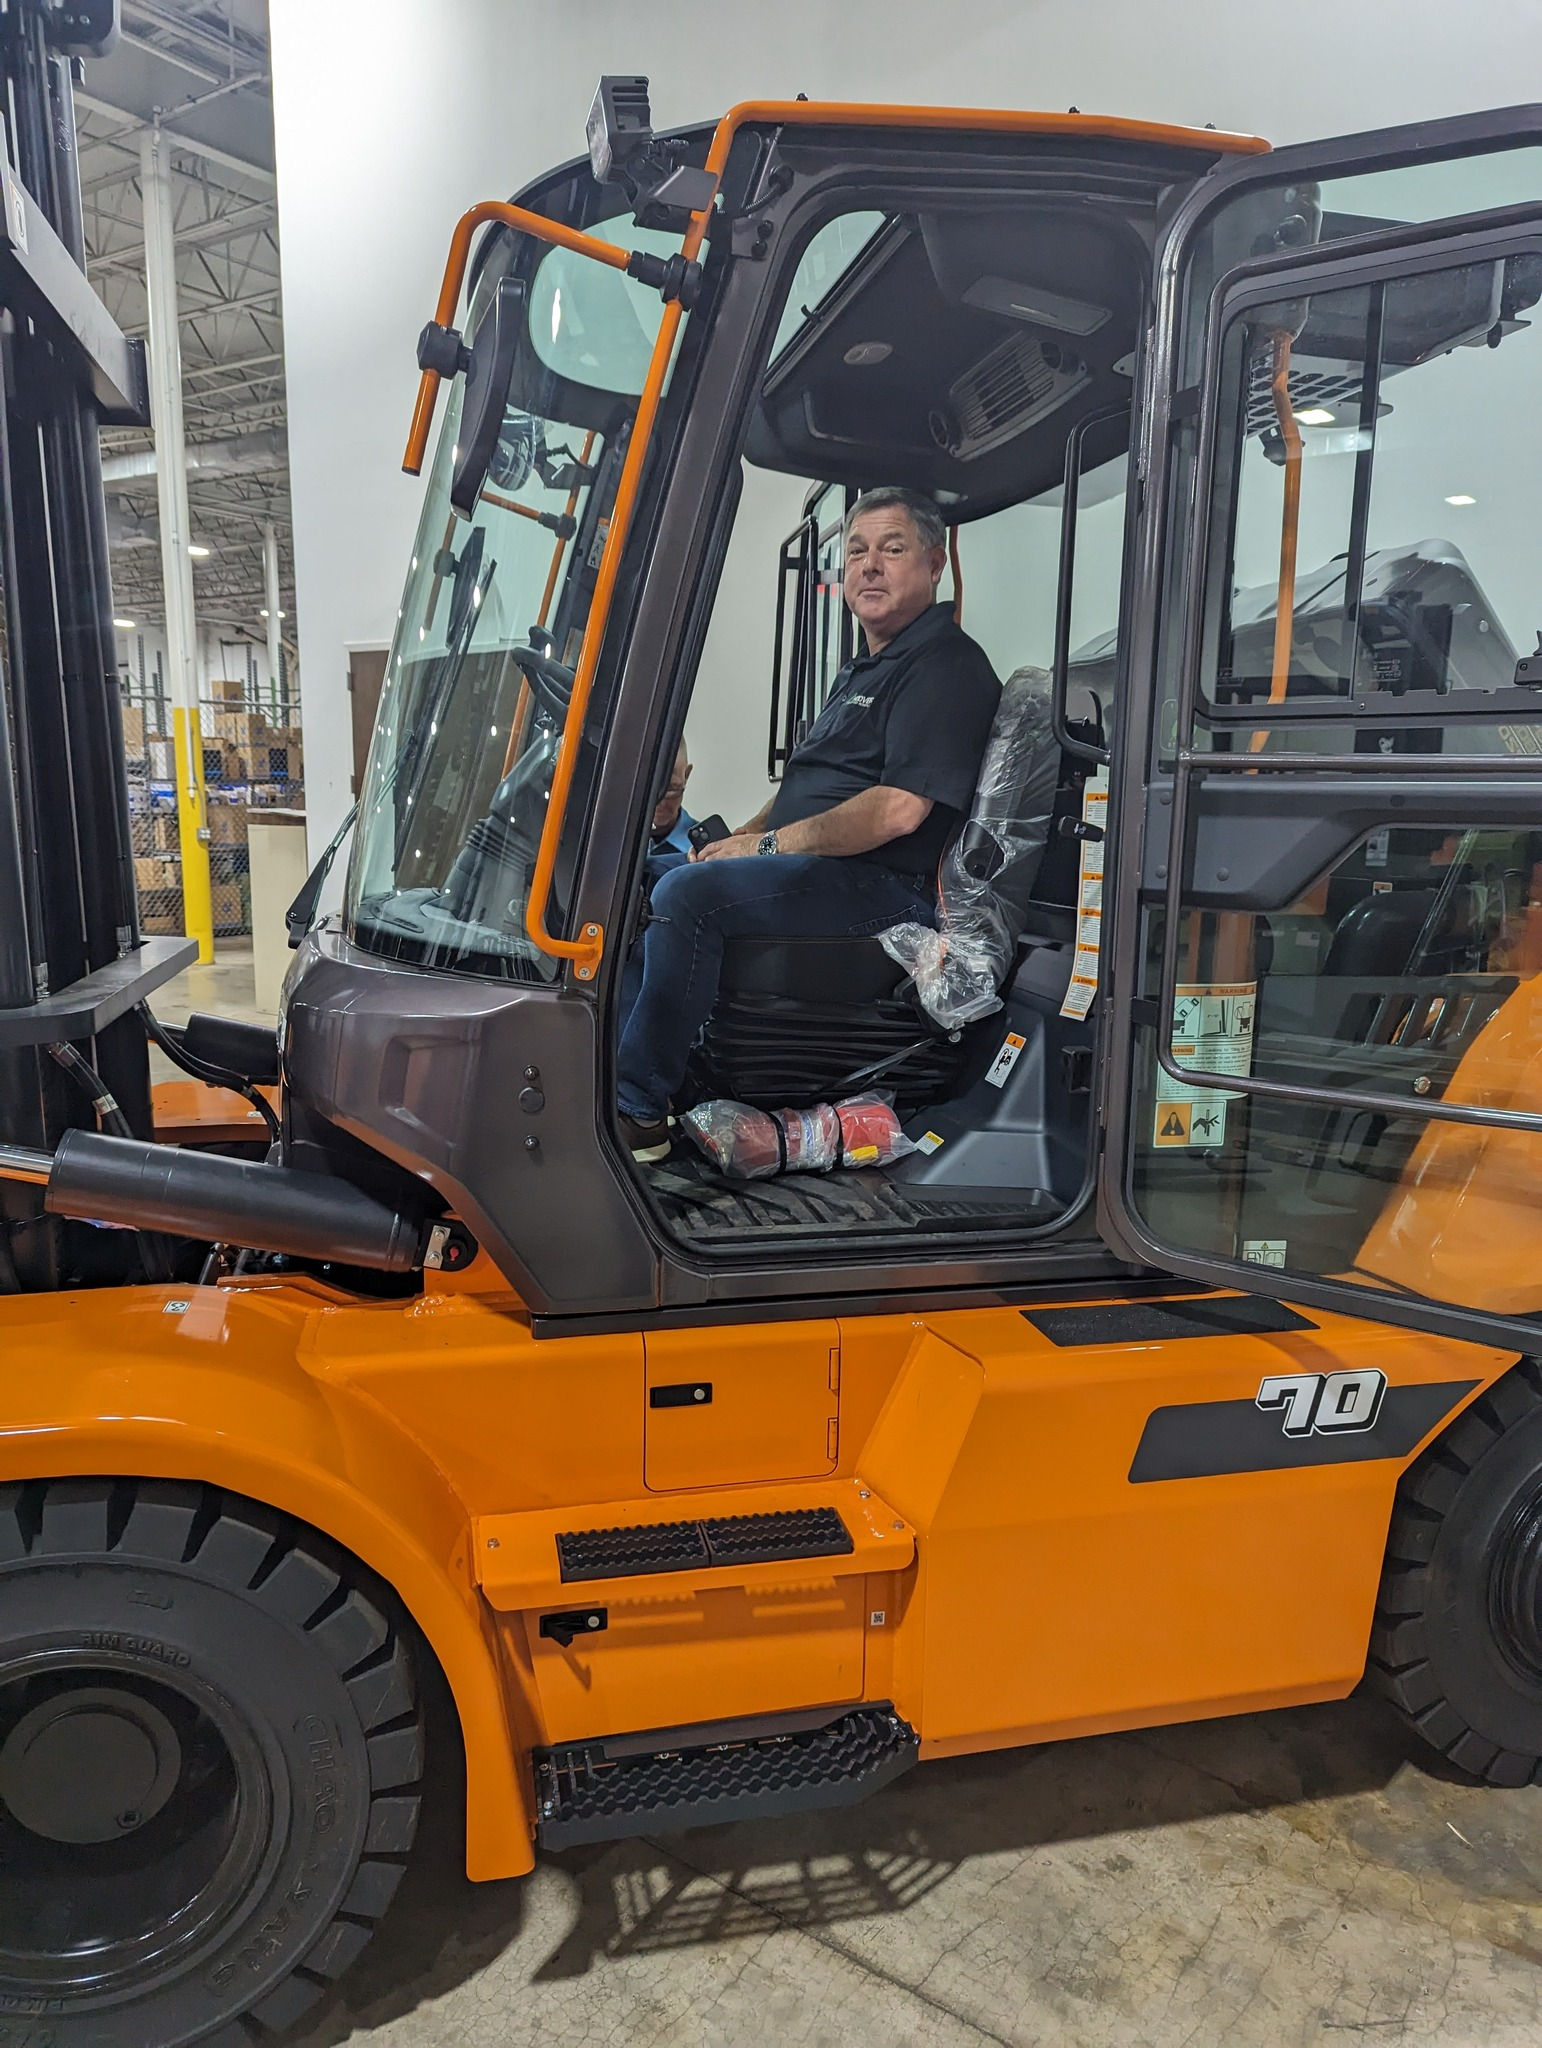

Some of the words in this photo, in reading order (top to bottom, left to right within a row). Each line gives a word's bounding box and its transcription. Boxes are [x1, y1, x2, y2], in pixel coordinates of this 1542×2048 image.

[1254, 1367, 1388, 1438] 70
[80, 1632, 120, 1648] RIM
[125, 1636, 192, 1668] GUARD
